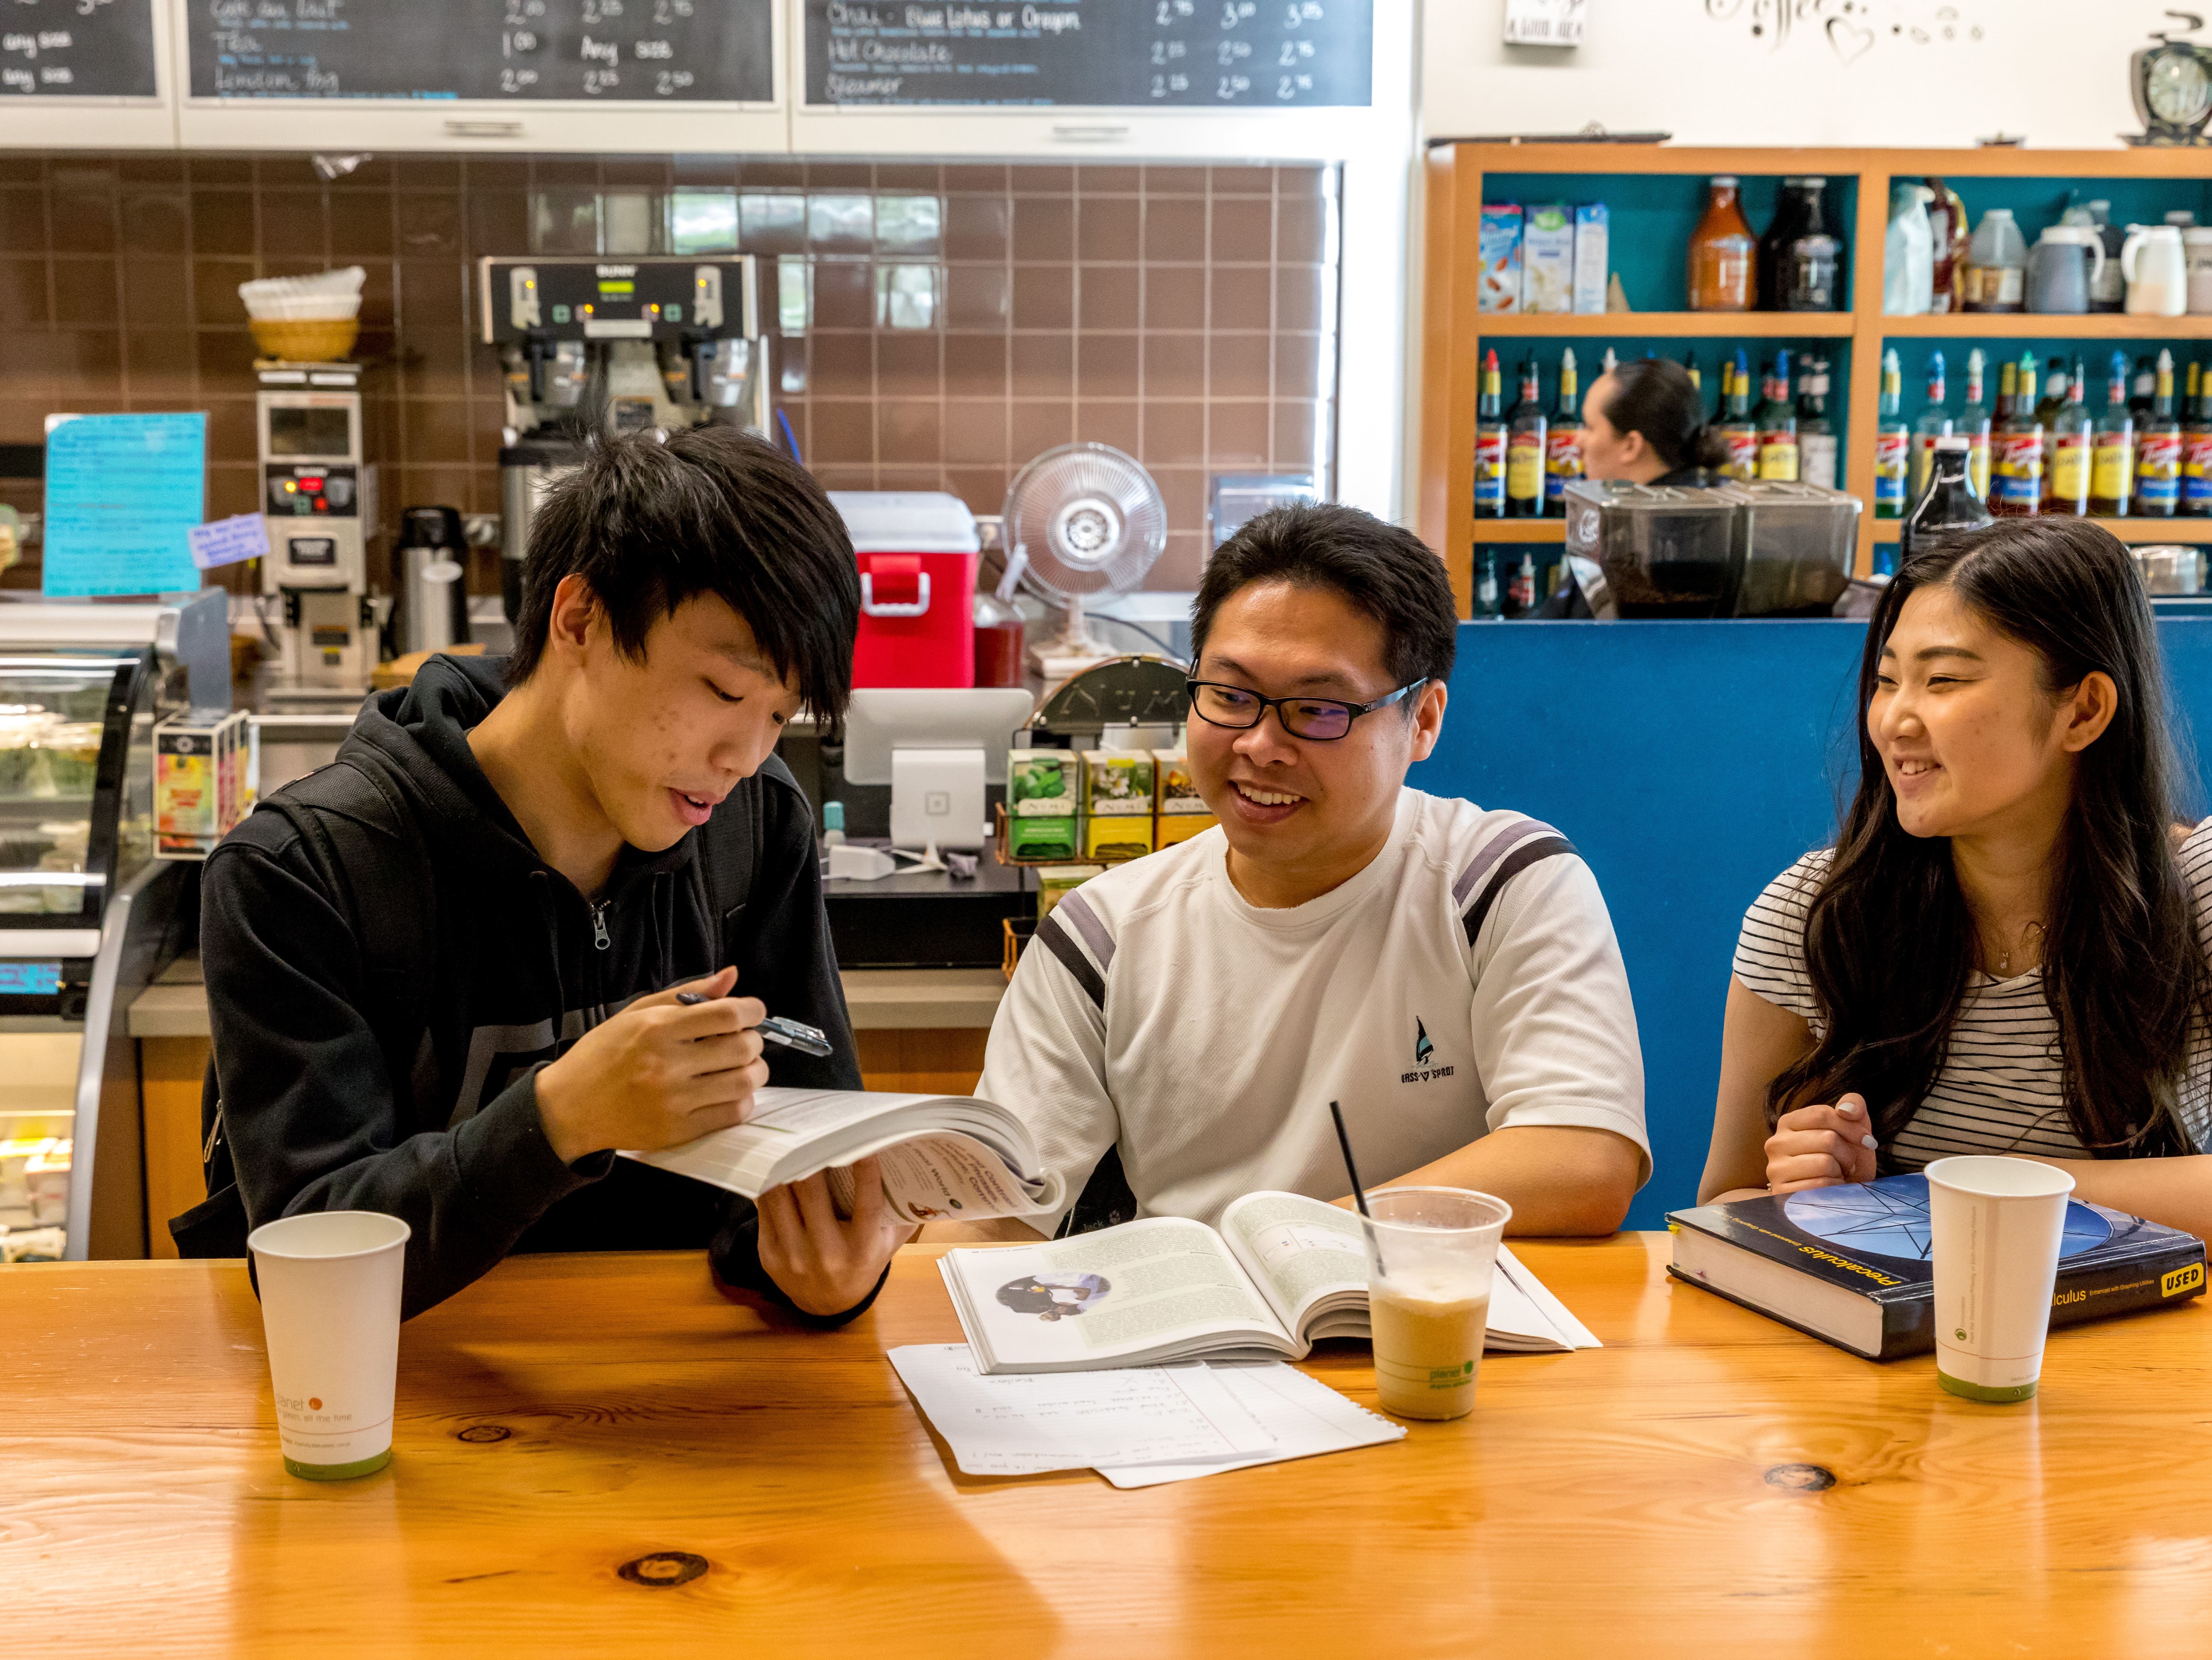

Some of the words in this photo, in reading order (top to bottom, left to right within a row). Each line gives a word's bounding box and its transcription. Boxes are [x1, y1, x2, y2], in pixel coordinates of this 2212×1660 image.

[1799, 1246, 1902, 1286] Precalculus
[2089, 1287, 2110, 1296] Enhanced
[2120, 1282, 2139, 1291] Graphing
[2166, 1269, 2199, 1291] USED
